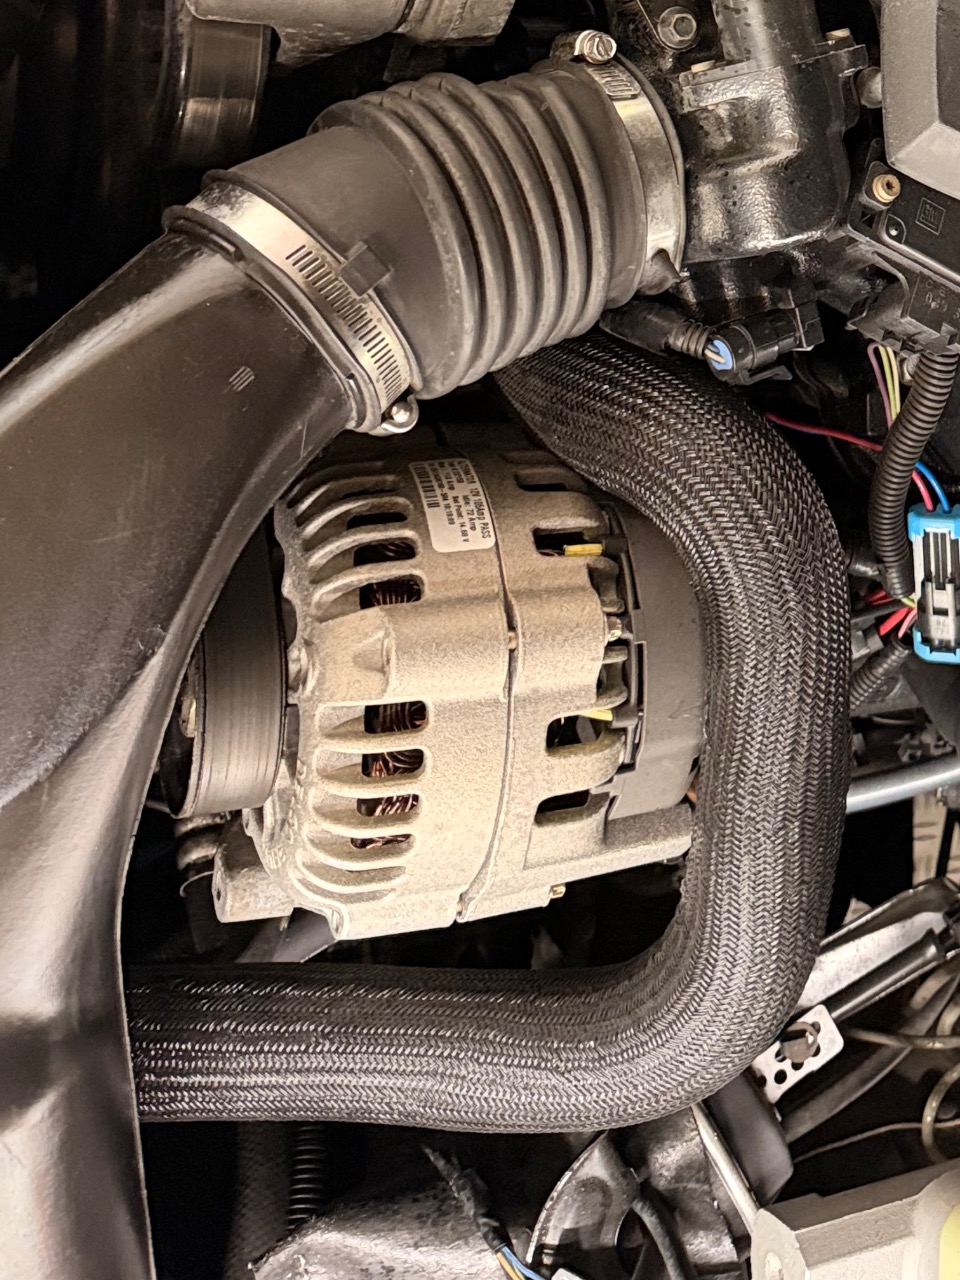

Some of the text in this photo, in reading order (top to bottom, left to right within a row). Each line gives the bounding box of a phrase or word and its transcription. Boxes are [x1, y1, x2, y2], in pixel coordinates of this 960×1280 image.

[466, 508, 474, 516] 72
[468, 518, 476, 531] Amp
[480, 523, 492, 538] PASS
